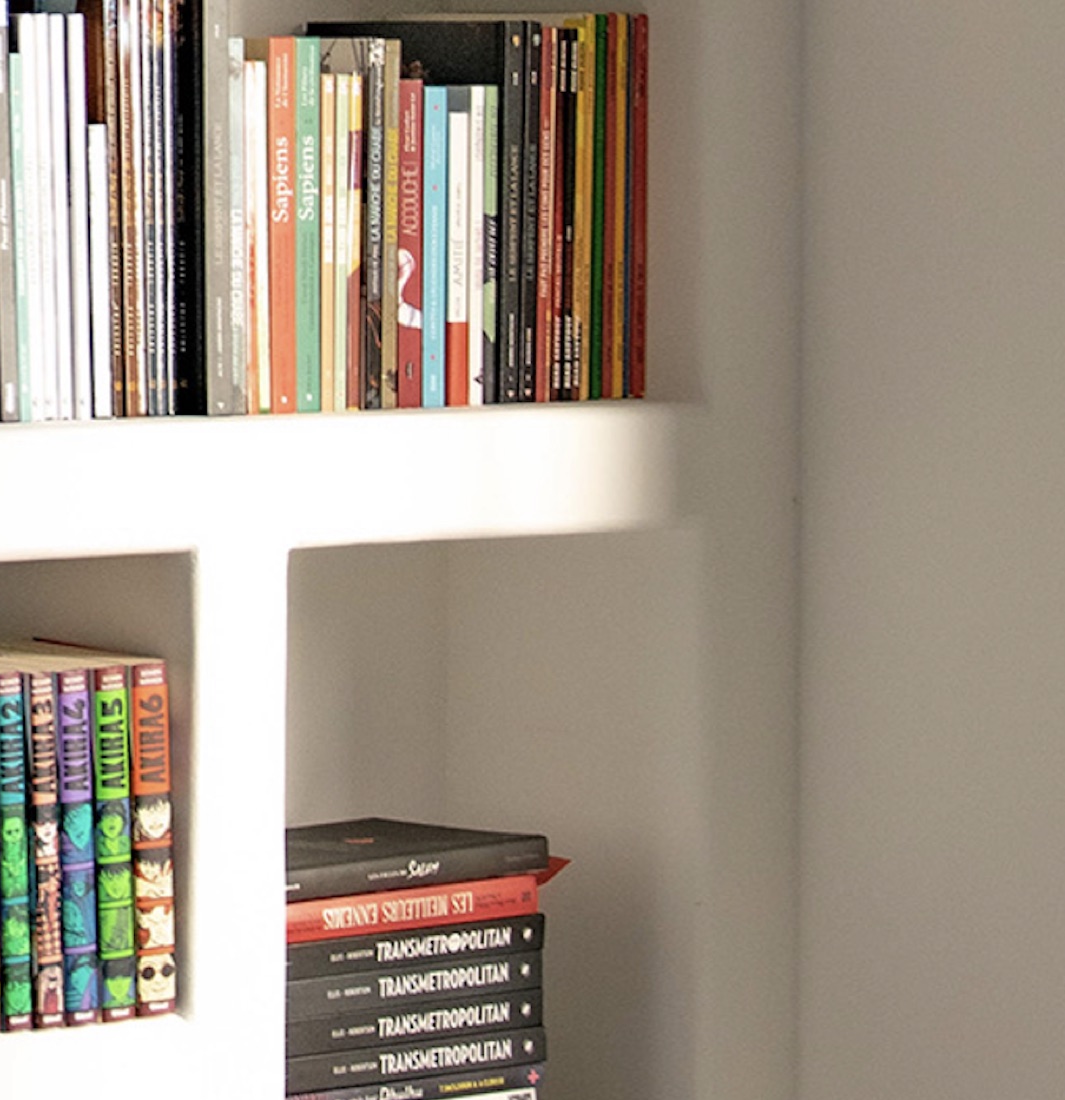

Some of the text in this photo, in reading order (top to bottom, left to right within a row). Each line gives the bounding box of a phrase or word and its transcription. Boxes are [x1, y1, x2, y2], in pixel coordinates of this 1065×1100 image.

[272, 136, 294, 223] Sapiens
[298, 134, 319, 221] Sapiens
[510, 144, 519, 181] LANCE
[510, 182, 518, 199] LA
[510, 200, 518, 214] ET
[322, 891, 474, 930] LES MEILLEURS ENNEMIS
[376, 927, 512, 962] TRANSMETROPOLITAN
[378, 962, 510, 998] TRANSMETROPOLITAN
[378, 1001, 511, 1038] TRANSMETROPOLITAN
[380, 1039, 513, 1075] TRANSMETROPOLITAN
